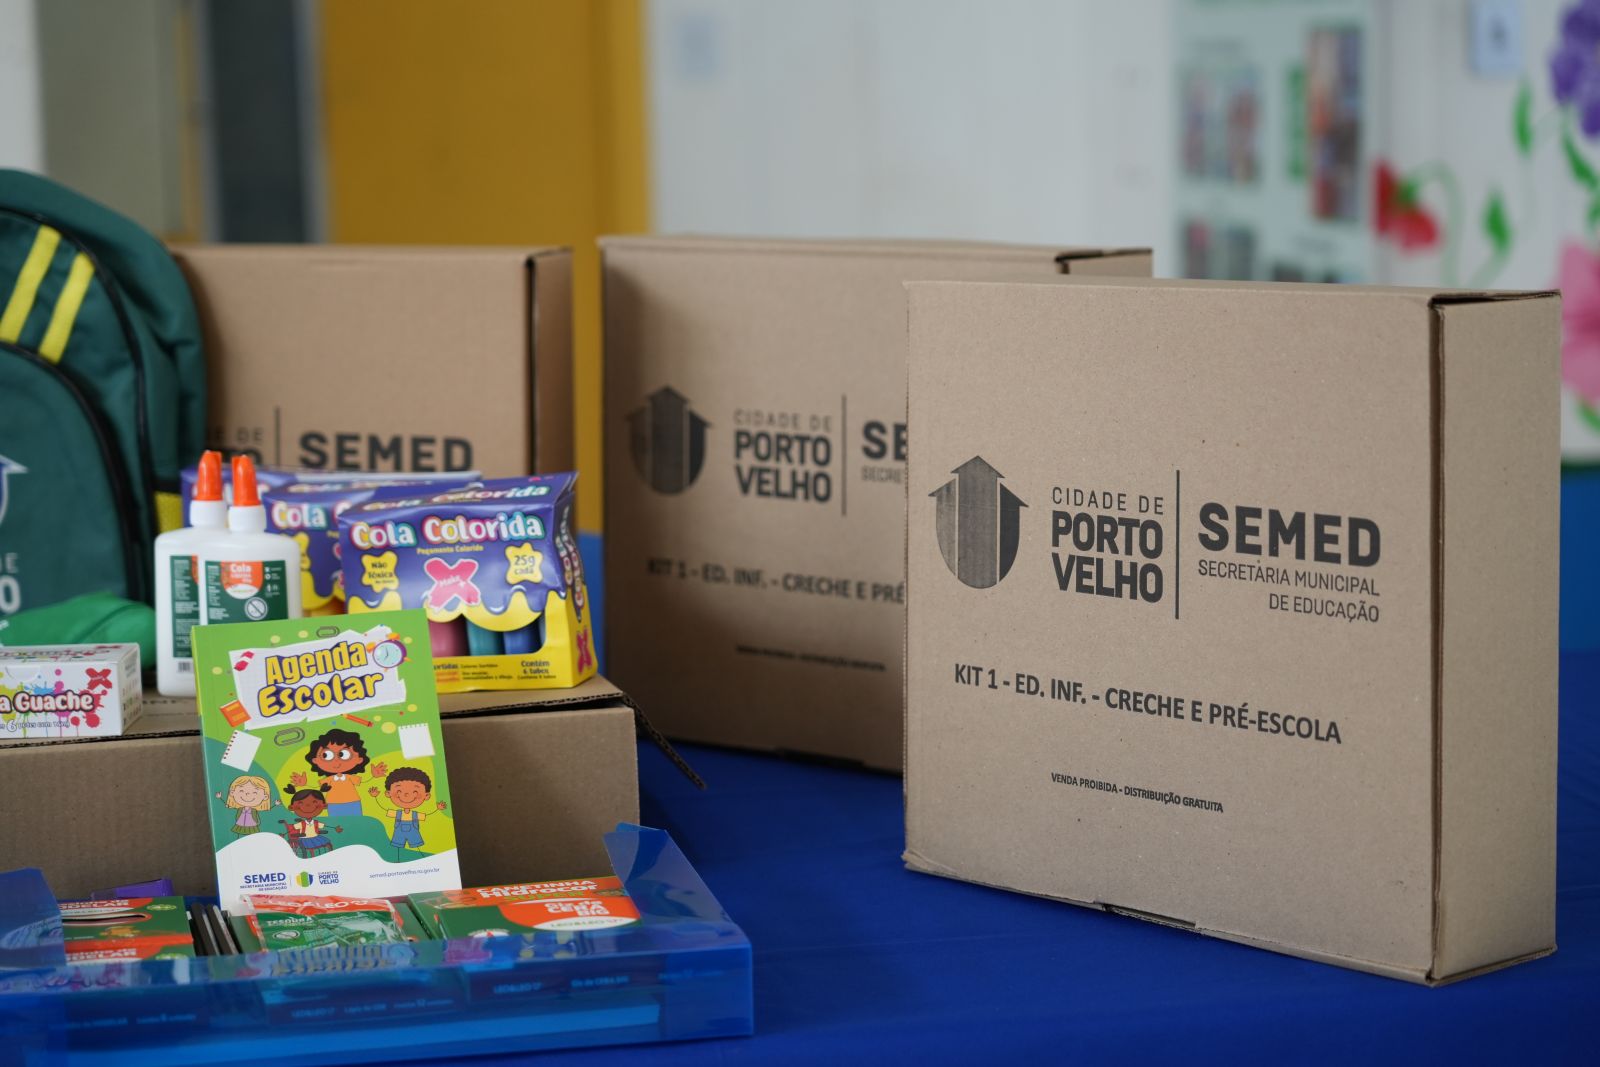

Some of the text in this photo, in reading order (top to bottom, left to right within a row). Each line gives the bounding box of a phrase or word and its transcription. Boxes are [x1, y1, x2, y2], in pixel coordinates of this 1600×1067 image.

[733, 409, 833, 432] CIDADE DE
[298, 431, 474, 473] SEMED
[734, 430, 832, 466] PORTO
[734, 465, 832, 502] VELHO
[1052, 486, 1164, 516] CIDADE DE
[271, 500, 328, 530] Cola
[350, 511, 545, 550] Cola Colorida
[1052, 510, 1163, 559] PORTO
[1198, 502, 1381, 567] SEMED
[514, 555, 536, 567] 25g
[1052, 552, 1163, 603] VELHO
[1198, 559, 1381, 597] SECRETARIA MUNICIPAL
[1269, 593, 1379, 623] DE EDUCAÇÃO
[265, 640, 368, 685] Agenda
[13, 690, 94, 713] Guache
[257, 672, 384, 718] Escolar
[955, 663, 983, 686] KIT
[988, 669, 998, 690] 1
[1015, 672, 1045, 698] ED.
[1051, 678, 1087, 705] INF.
[1105, 687, 1185, 720] CRECHE
[1191, 700, 1203, 722] E
[1209, 702, 1342, 744] PRÉ-ESCOLA
[1051, 772, 1078, 787] VENDA
[1080, 777, 1118, 794] PROIBIDA
[1124, 785, 1181, 805] DISTRIBUIÇÃO
[1182, 796, 1224, 813] GRATUITA
[244, 872, 286, 884] SEMED
